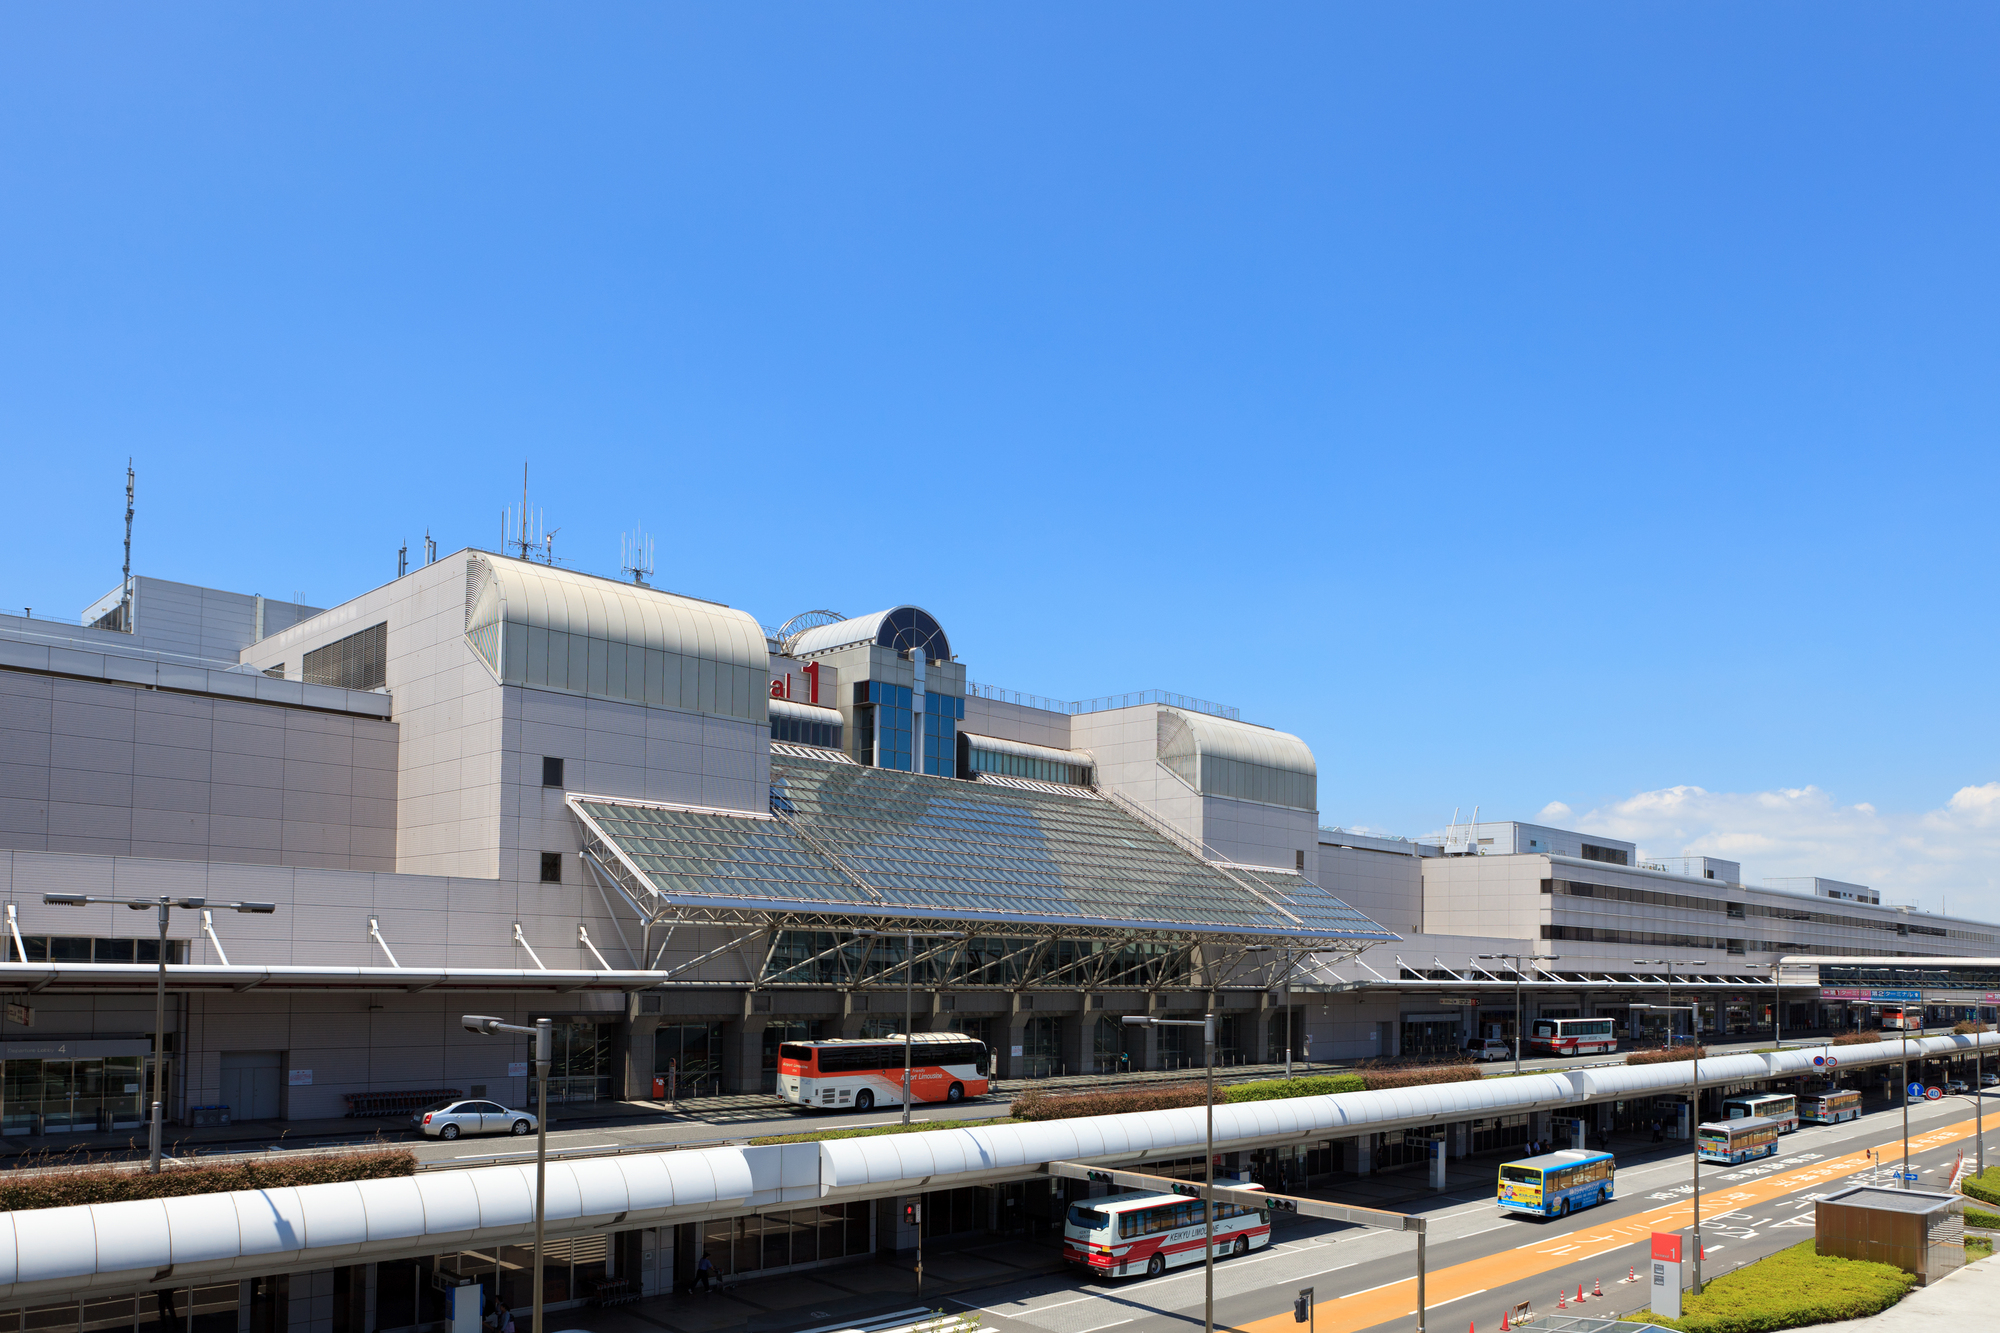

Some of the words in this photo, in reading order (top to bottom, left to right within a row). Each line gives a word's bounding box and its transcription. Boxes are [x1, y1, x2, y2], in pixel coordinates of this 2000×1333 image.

[801, 661, 819, 704] 1
[58, 1044, 66, 1054] 4
[918, 1072, 943, 1080] Limousine
[1929, 1090, 1939, 1098] 40
[1170, 1230, 1191, 1242] KEIKYU
[1670, 1247, 1676, 1260] 1
